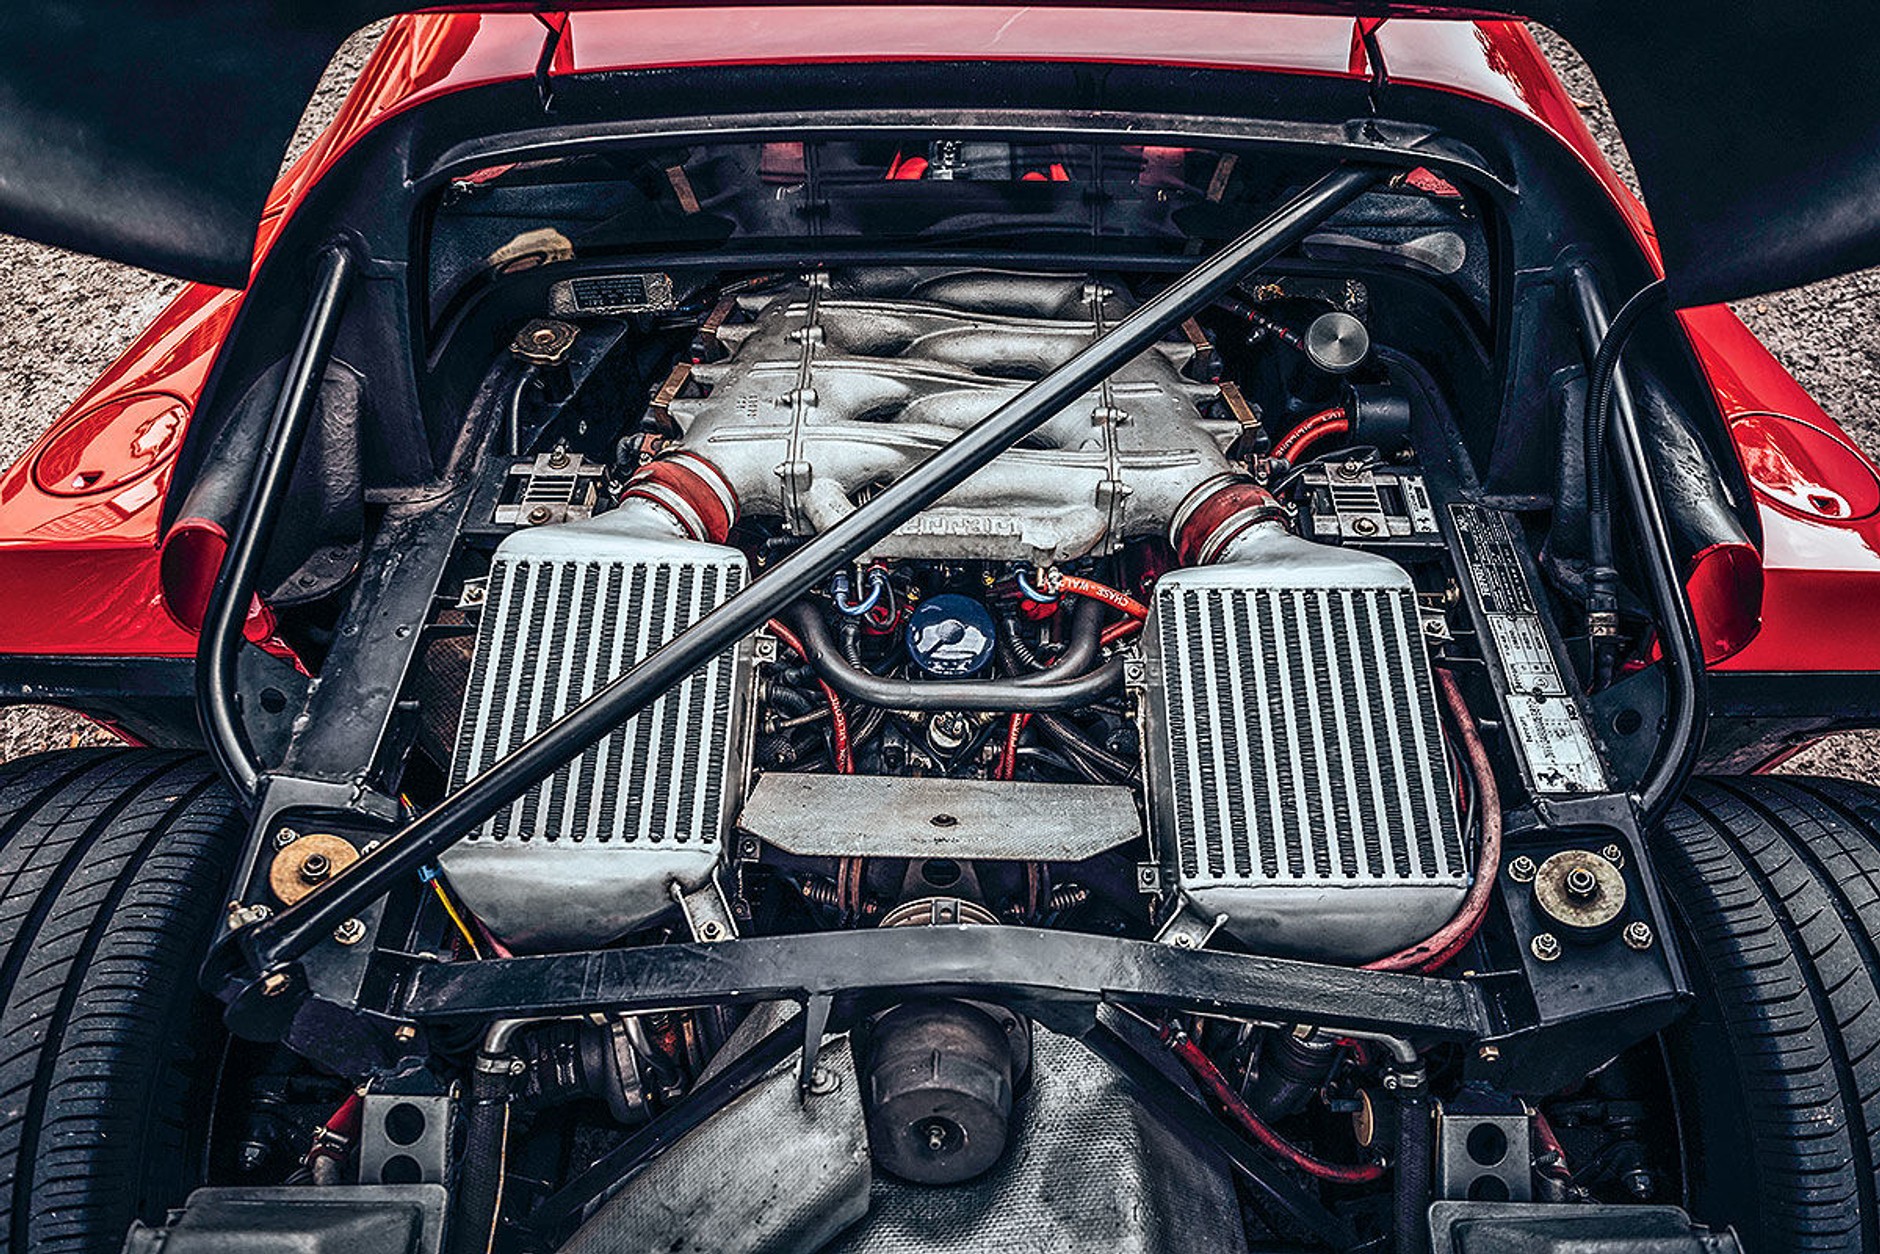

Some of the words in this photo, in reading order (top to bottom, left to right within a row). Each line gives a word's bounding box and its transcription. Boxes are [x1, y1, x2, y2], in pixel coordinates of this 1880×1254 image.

[892, 514, 1022, 536] errari
[1061, 577, 1090, 592] WAL
[1097, 586, 1129, 606] CHASE
